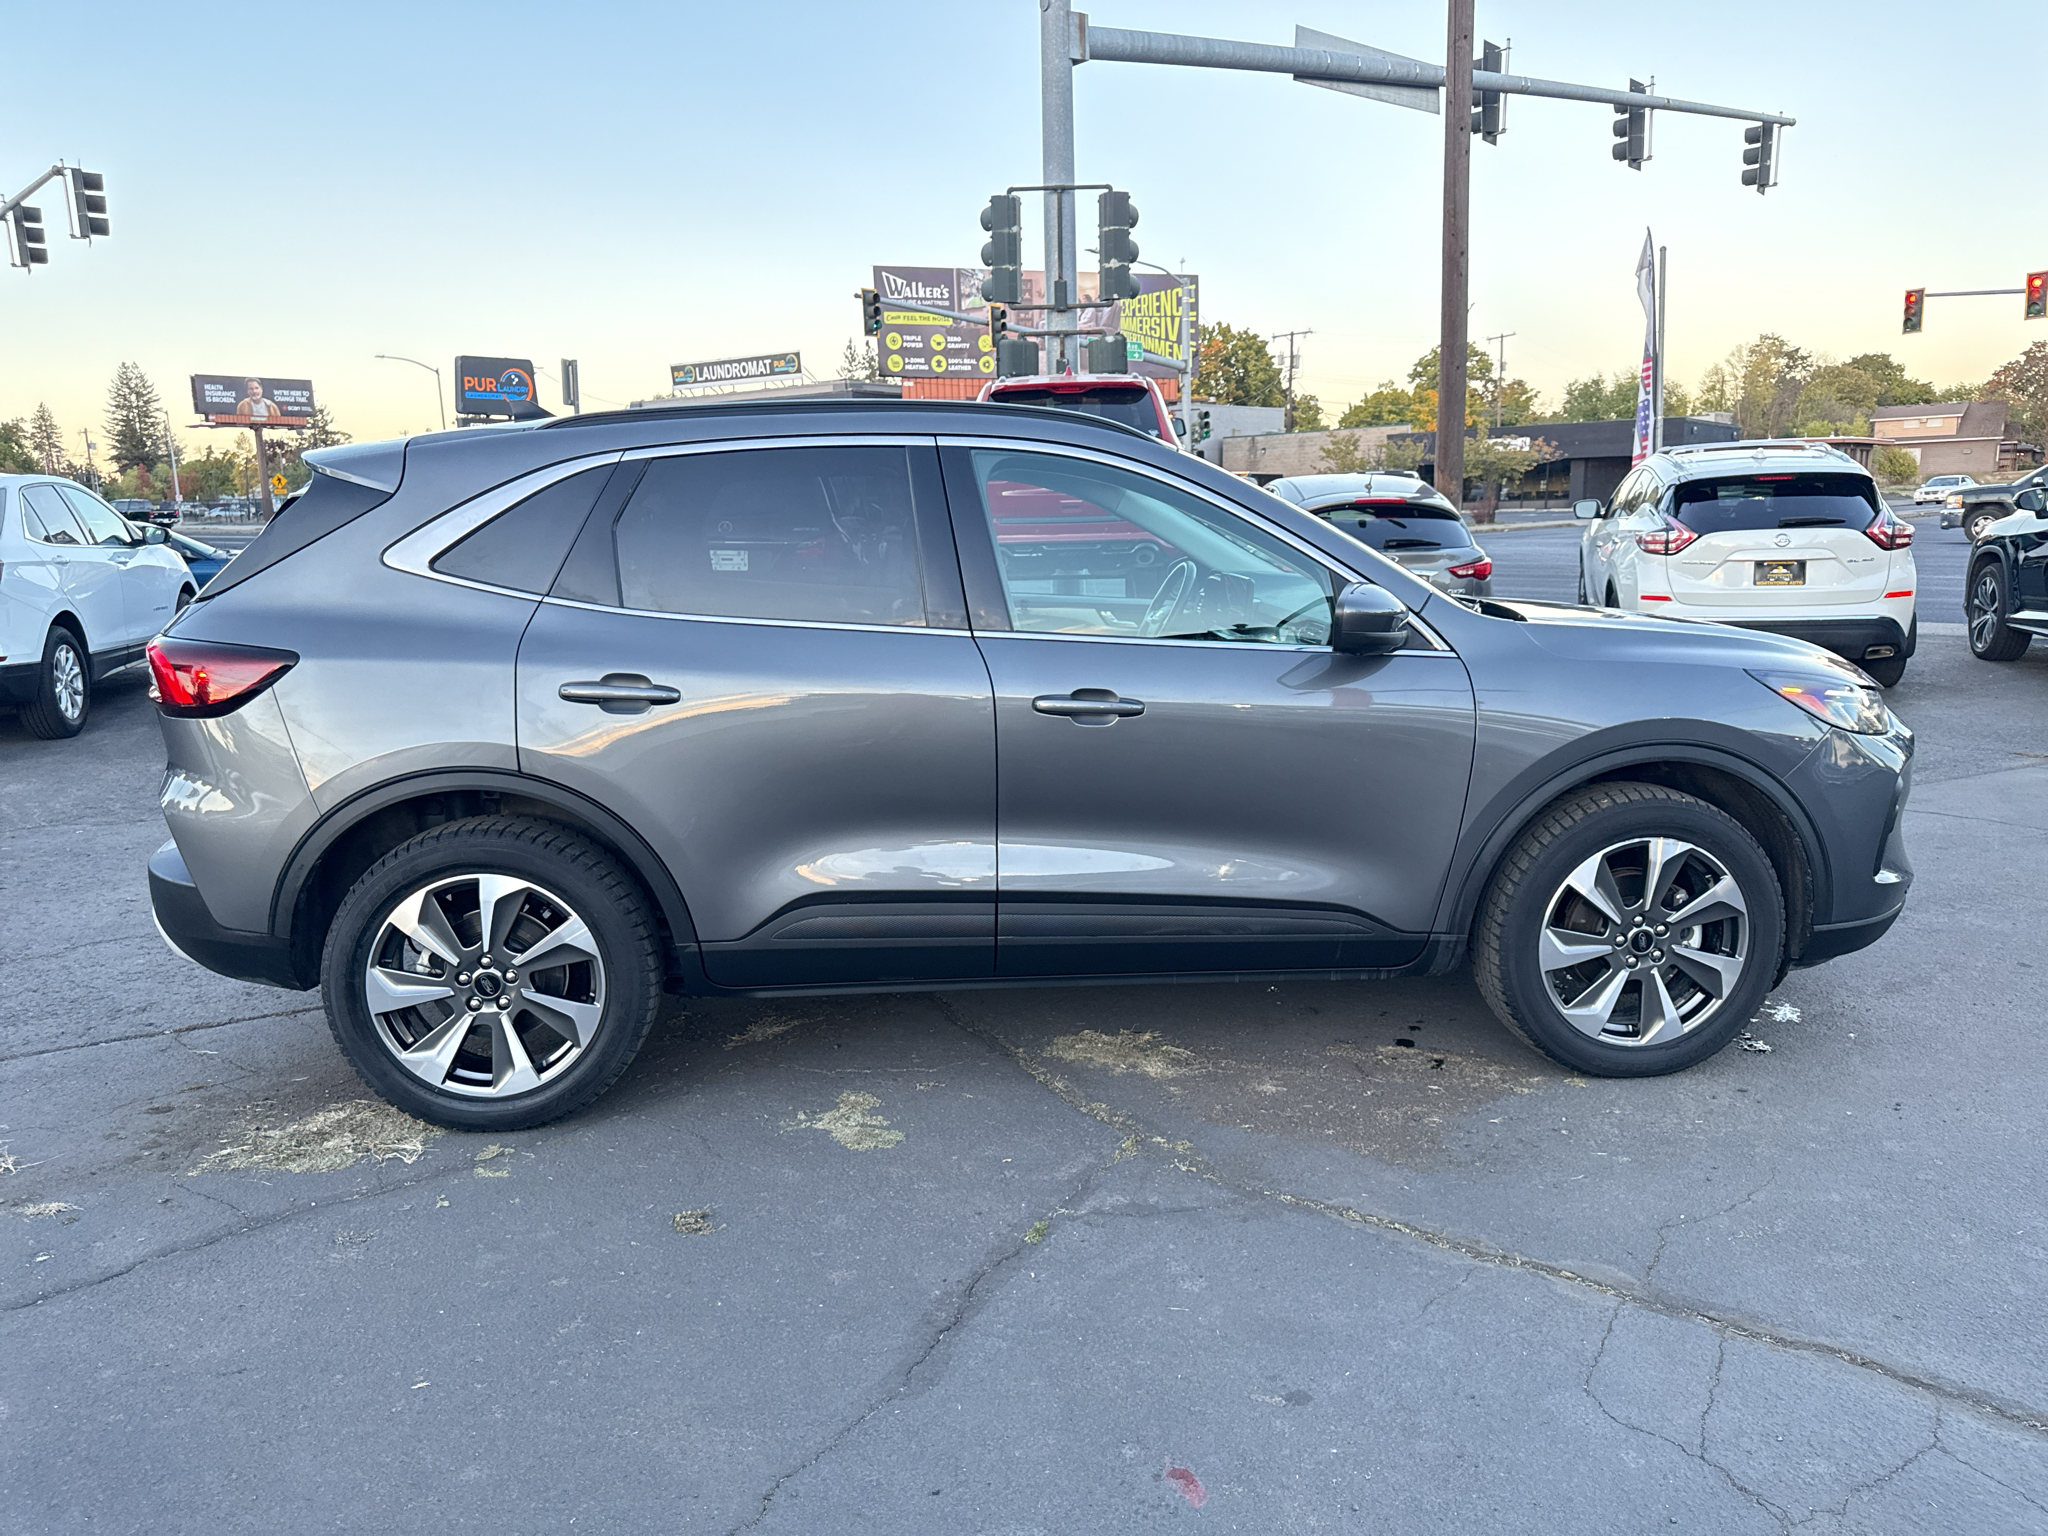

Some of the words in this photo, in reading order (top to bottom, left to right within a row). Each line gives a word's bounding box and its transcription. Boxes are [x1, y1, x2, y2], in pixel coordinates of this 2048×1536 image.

[674, 370, 685, 378] PUR
[695, 359, 771, 381] LAUNDROMAT
[463, 376, 497, 392] PUR
[497, 383, 529, 393] LAUNDRY
